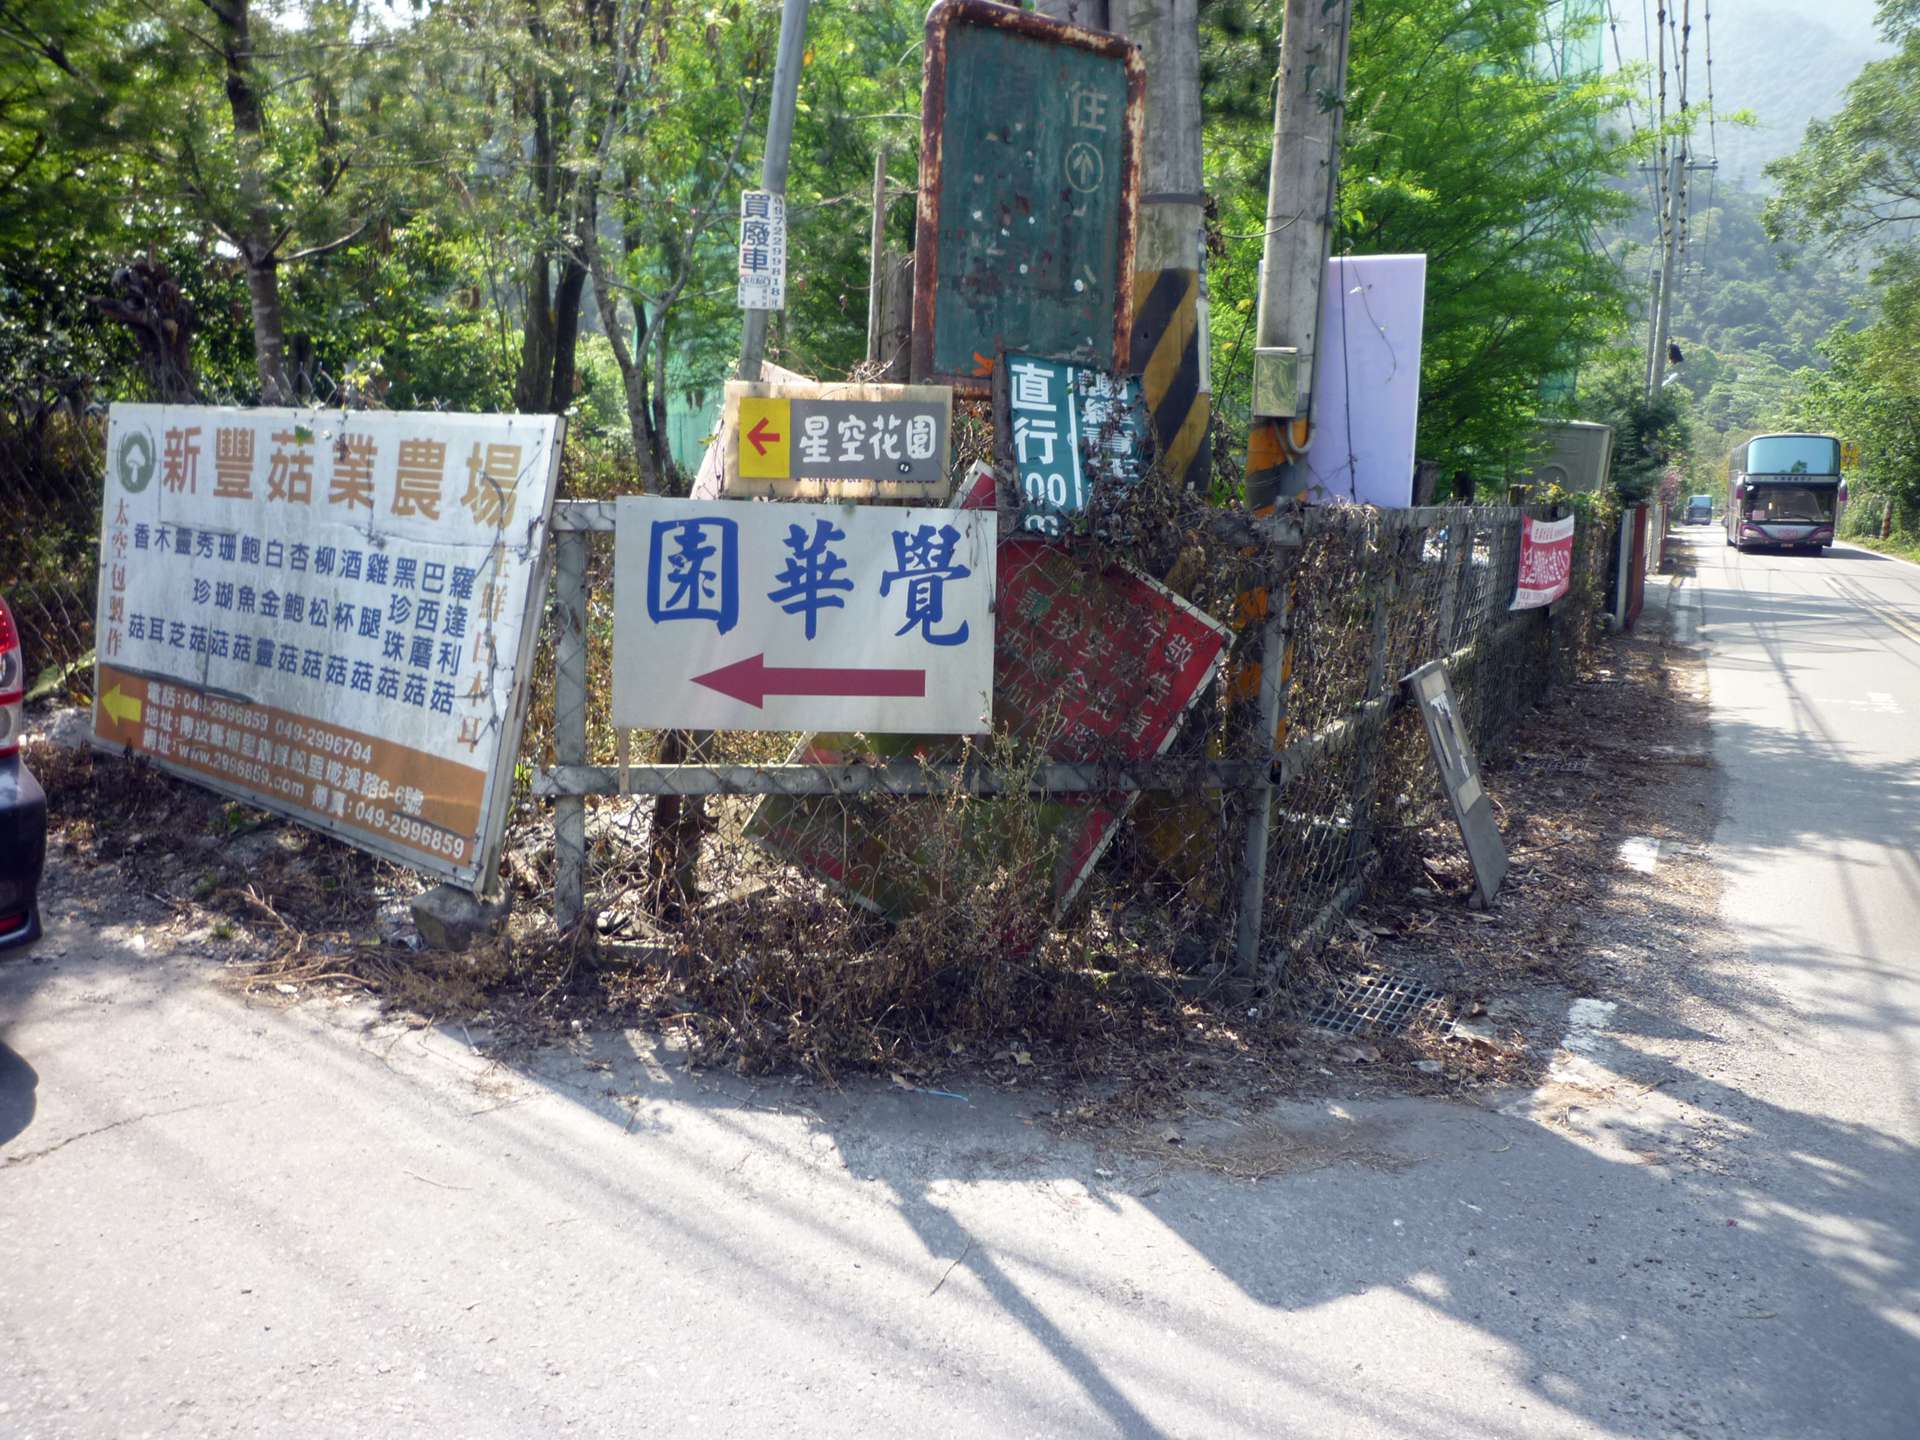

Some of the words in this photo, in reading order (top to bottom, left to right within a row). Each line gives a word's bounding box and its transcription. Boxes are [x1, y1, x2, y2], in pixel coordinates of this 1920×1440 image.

[741, 193, 770, 273] 買廢車
[799, 414, 937, 464] 星空花園
[1011, 362, 1058, 465] 直行
[163, 426, 522, 529] 新豐菇業農場
[1020, 472, 1067, 508] 00
[107, 497, 129, 656] 太空包製作
[275, 719, 373, 764] 049-2996794
